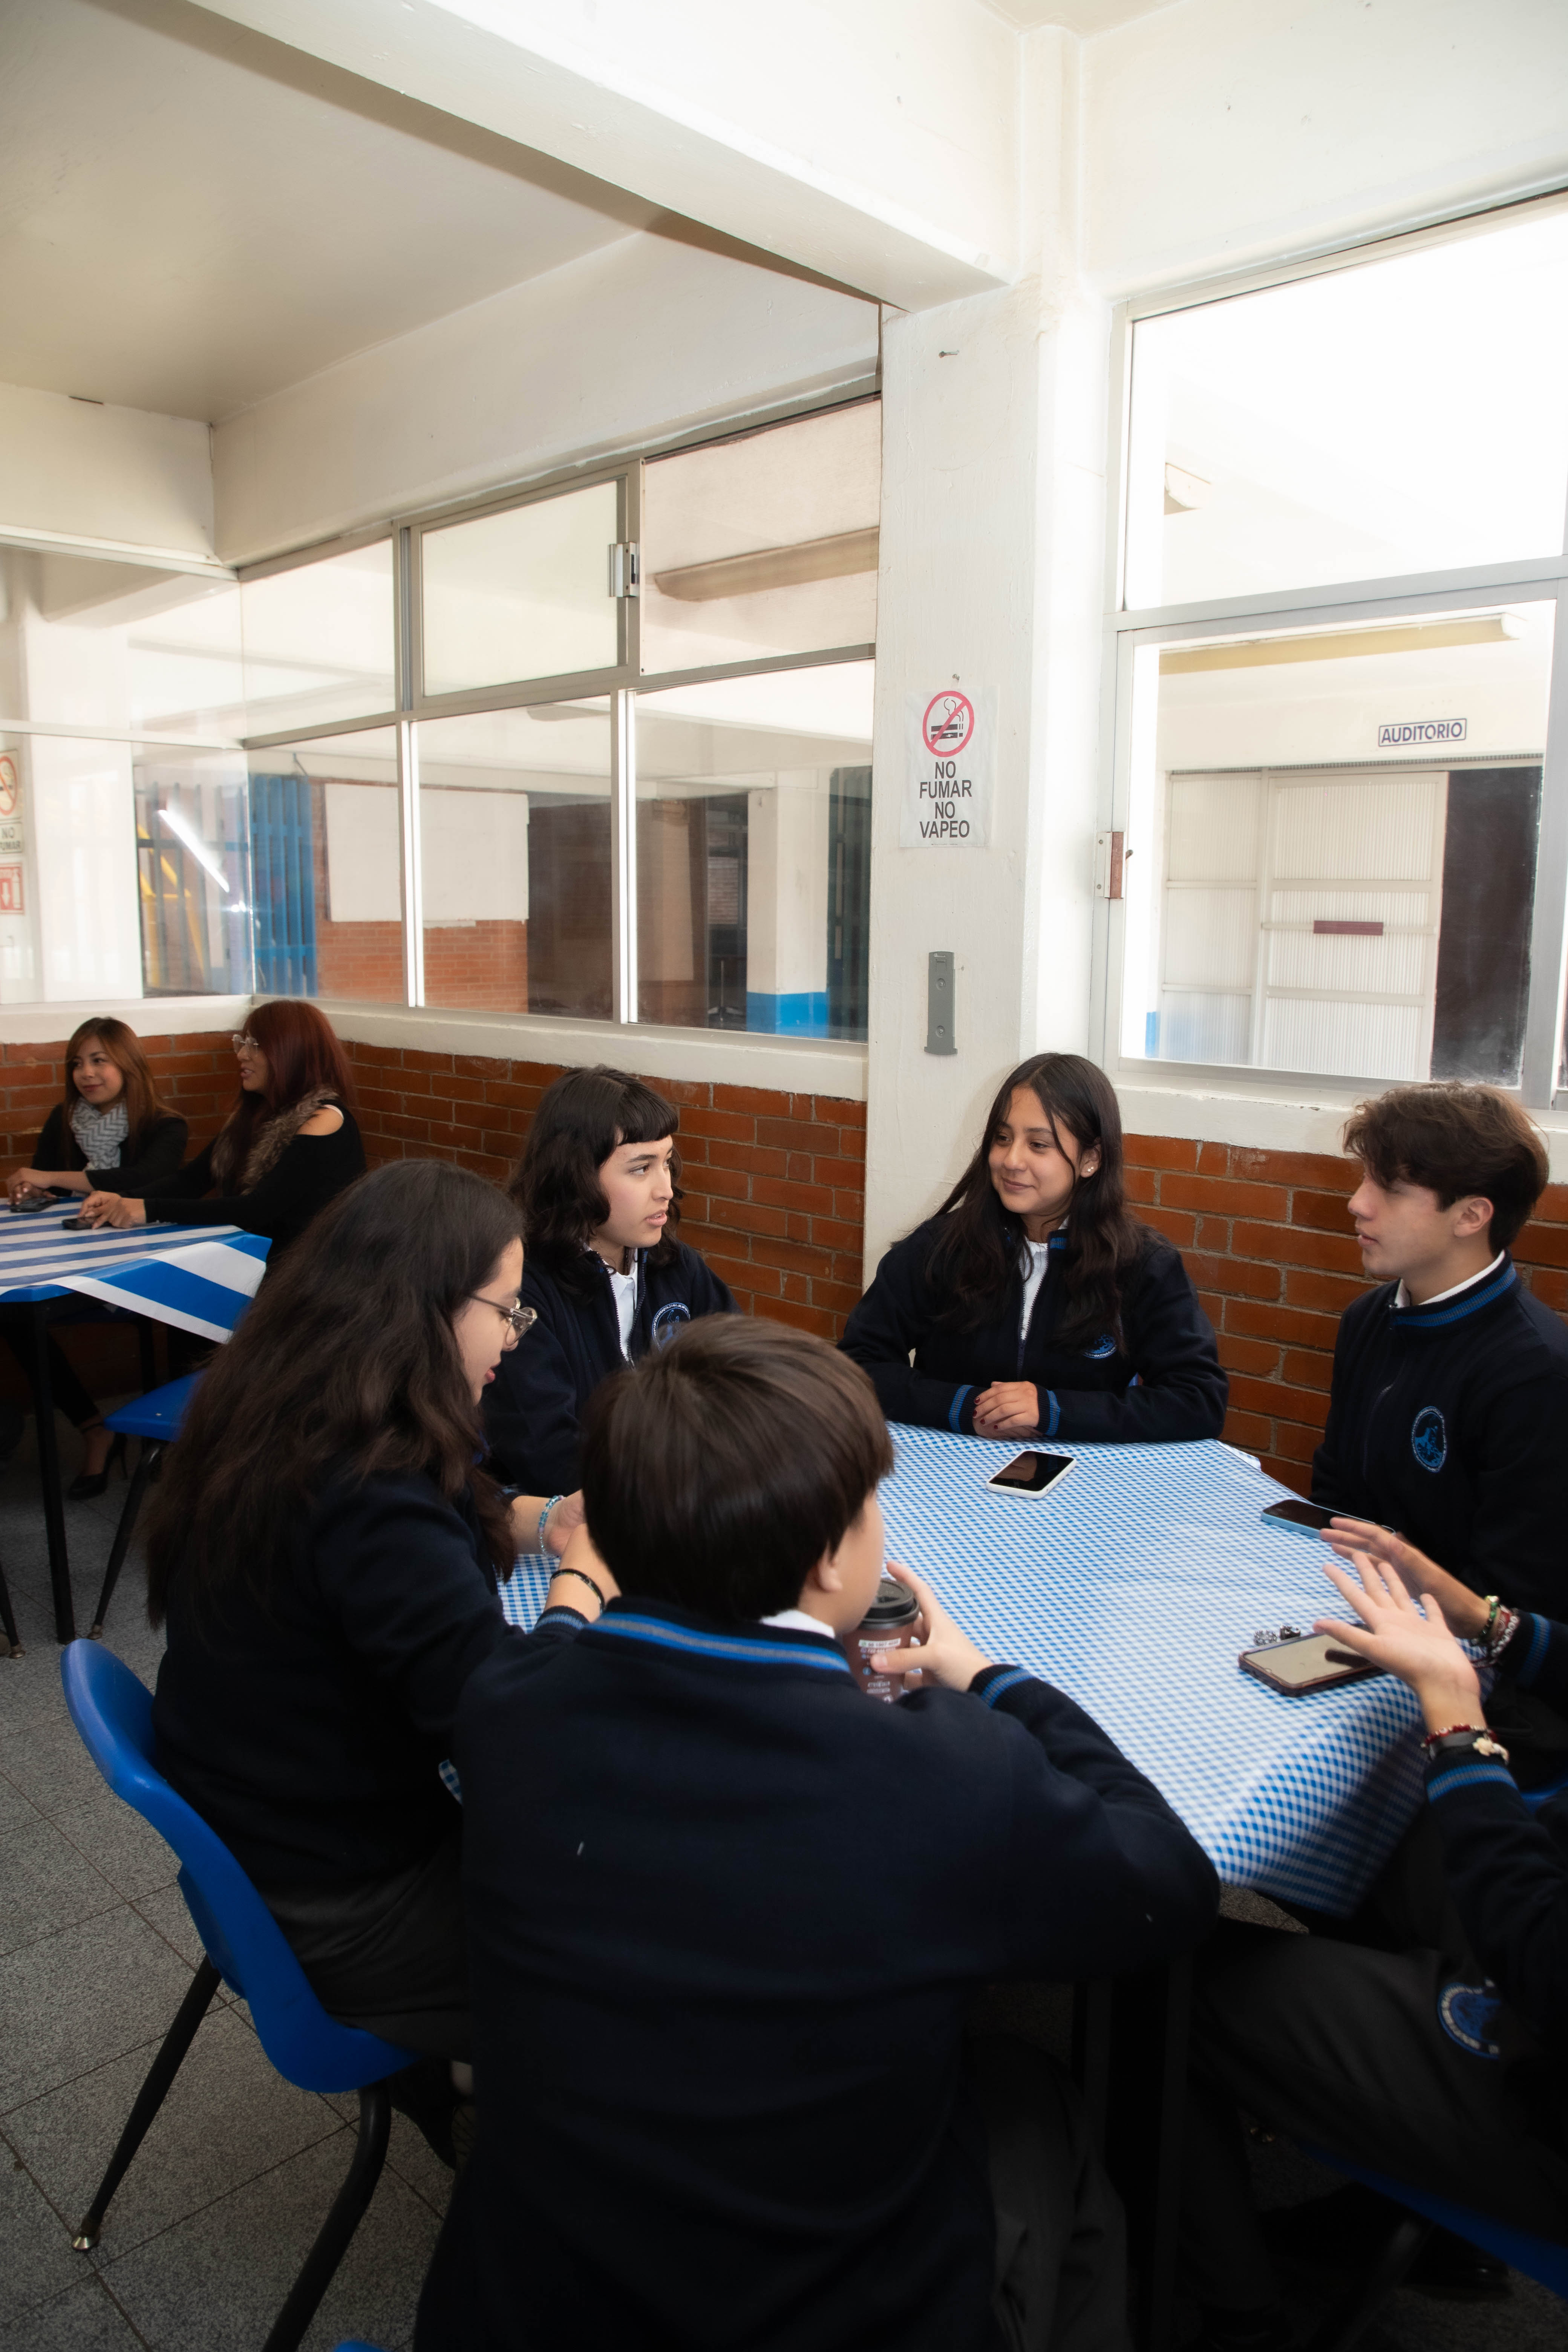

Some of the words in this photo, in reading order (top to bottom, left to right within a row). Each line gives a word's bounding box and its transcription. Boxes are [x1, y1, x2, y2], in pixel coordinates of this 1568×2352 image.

[1381, 722, 1462, 743] AUDITORIO
[935, 761, 956, 779] NO
[919, 780, 972, 799] FUMAR
[935, 801, 955, 819] NO
[2, 827, 14, 838] NO
[919, 820, 970, 838] VAPEO
